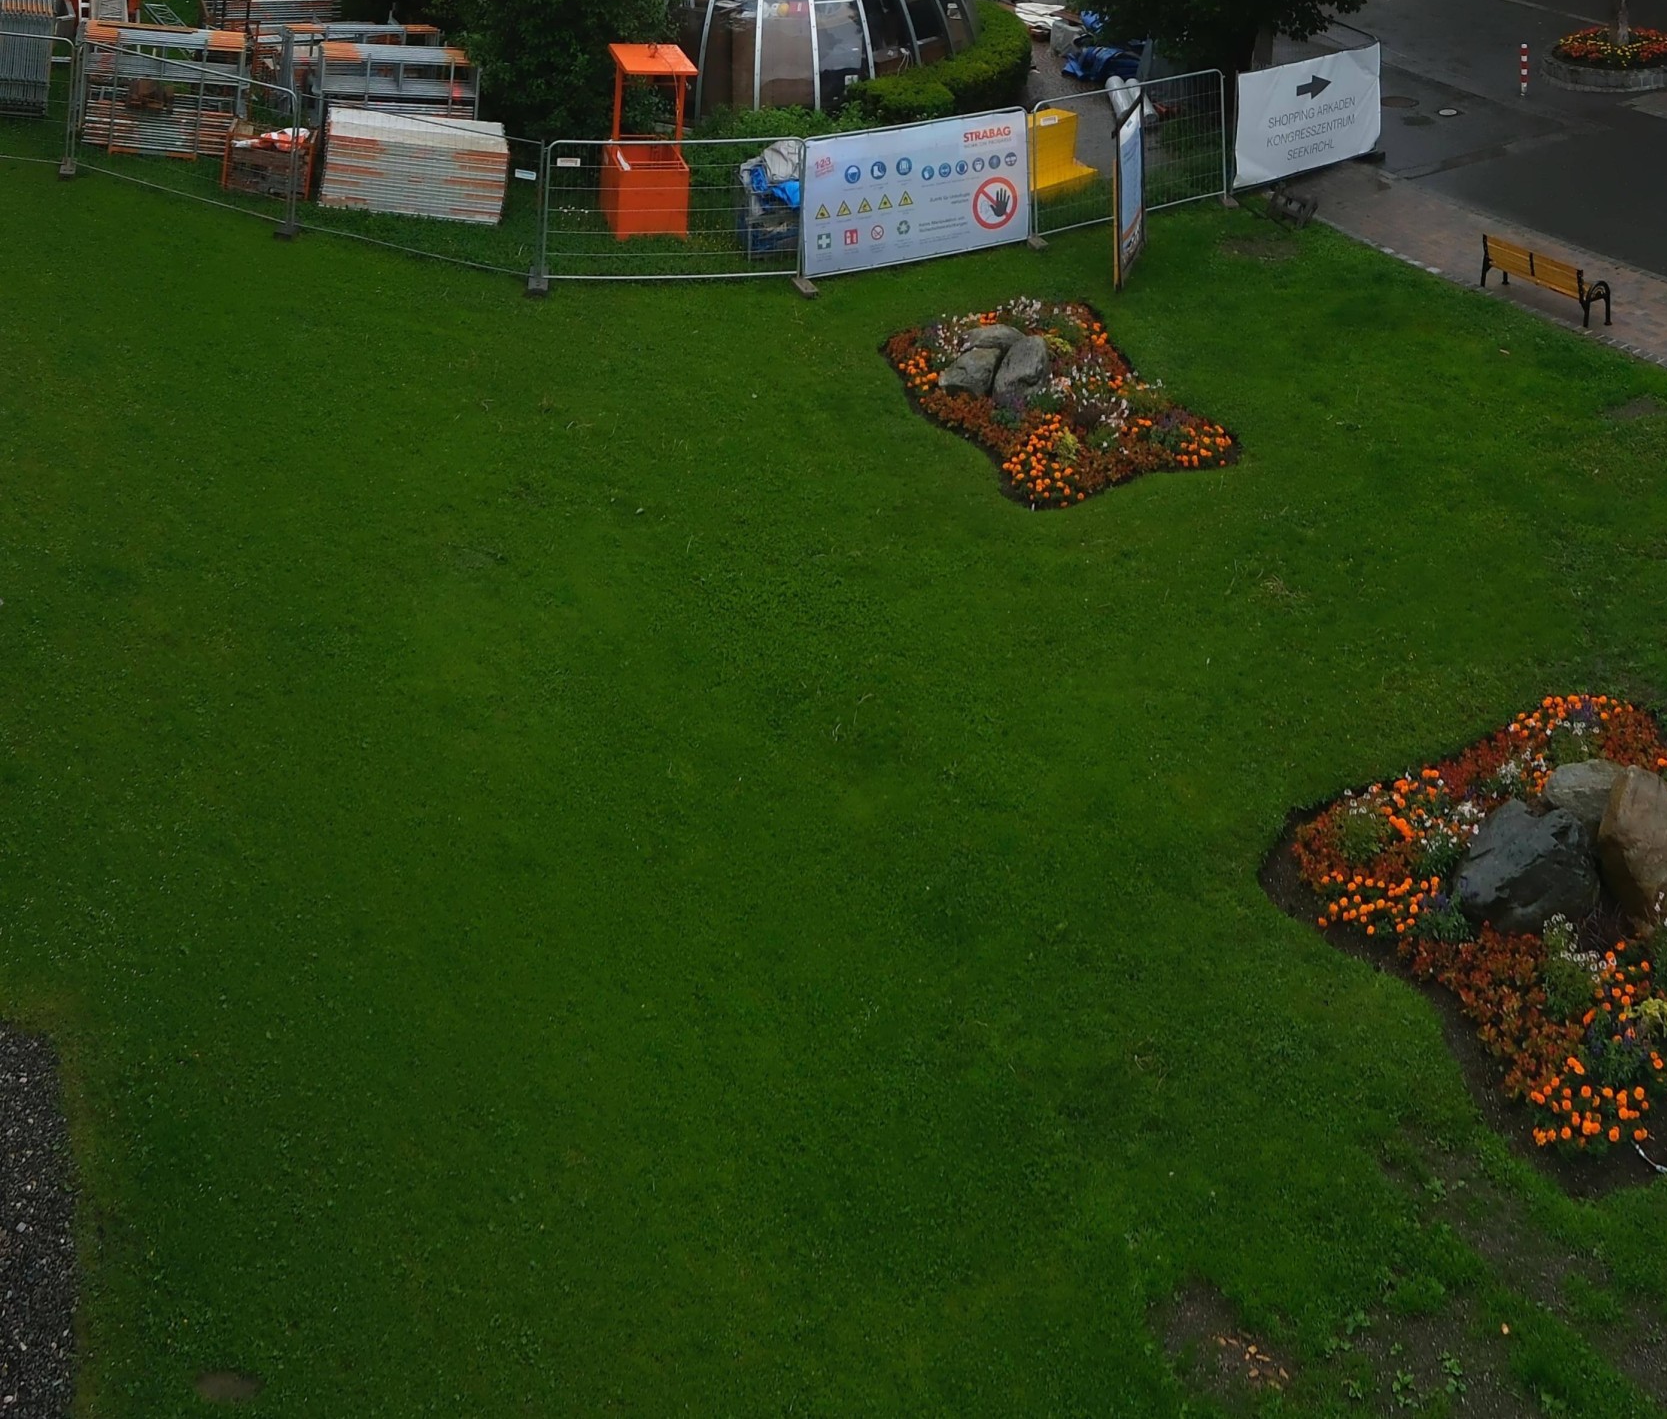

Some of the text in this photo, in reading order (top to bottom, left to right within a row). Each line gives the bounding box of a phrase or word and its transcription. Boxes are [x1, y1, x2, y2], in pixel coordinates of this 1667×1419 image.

[1267, 95, 1356, 130] SHOPPING ARKADEN
[963, 126, 1012, 143] STRABAG
[1266, 114, 1356, 148] KONGRESSZENTRUM
[1286, 139, 1335, 162] SEEKIRCHL
